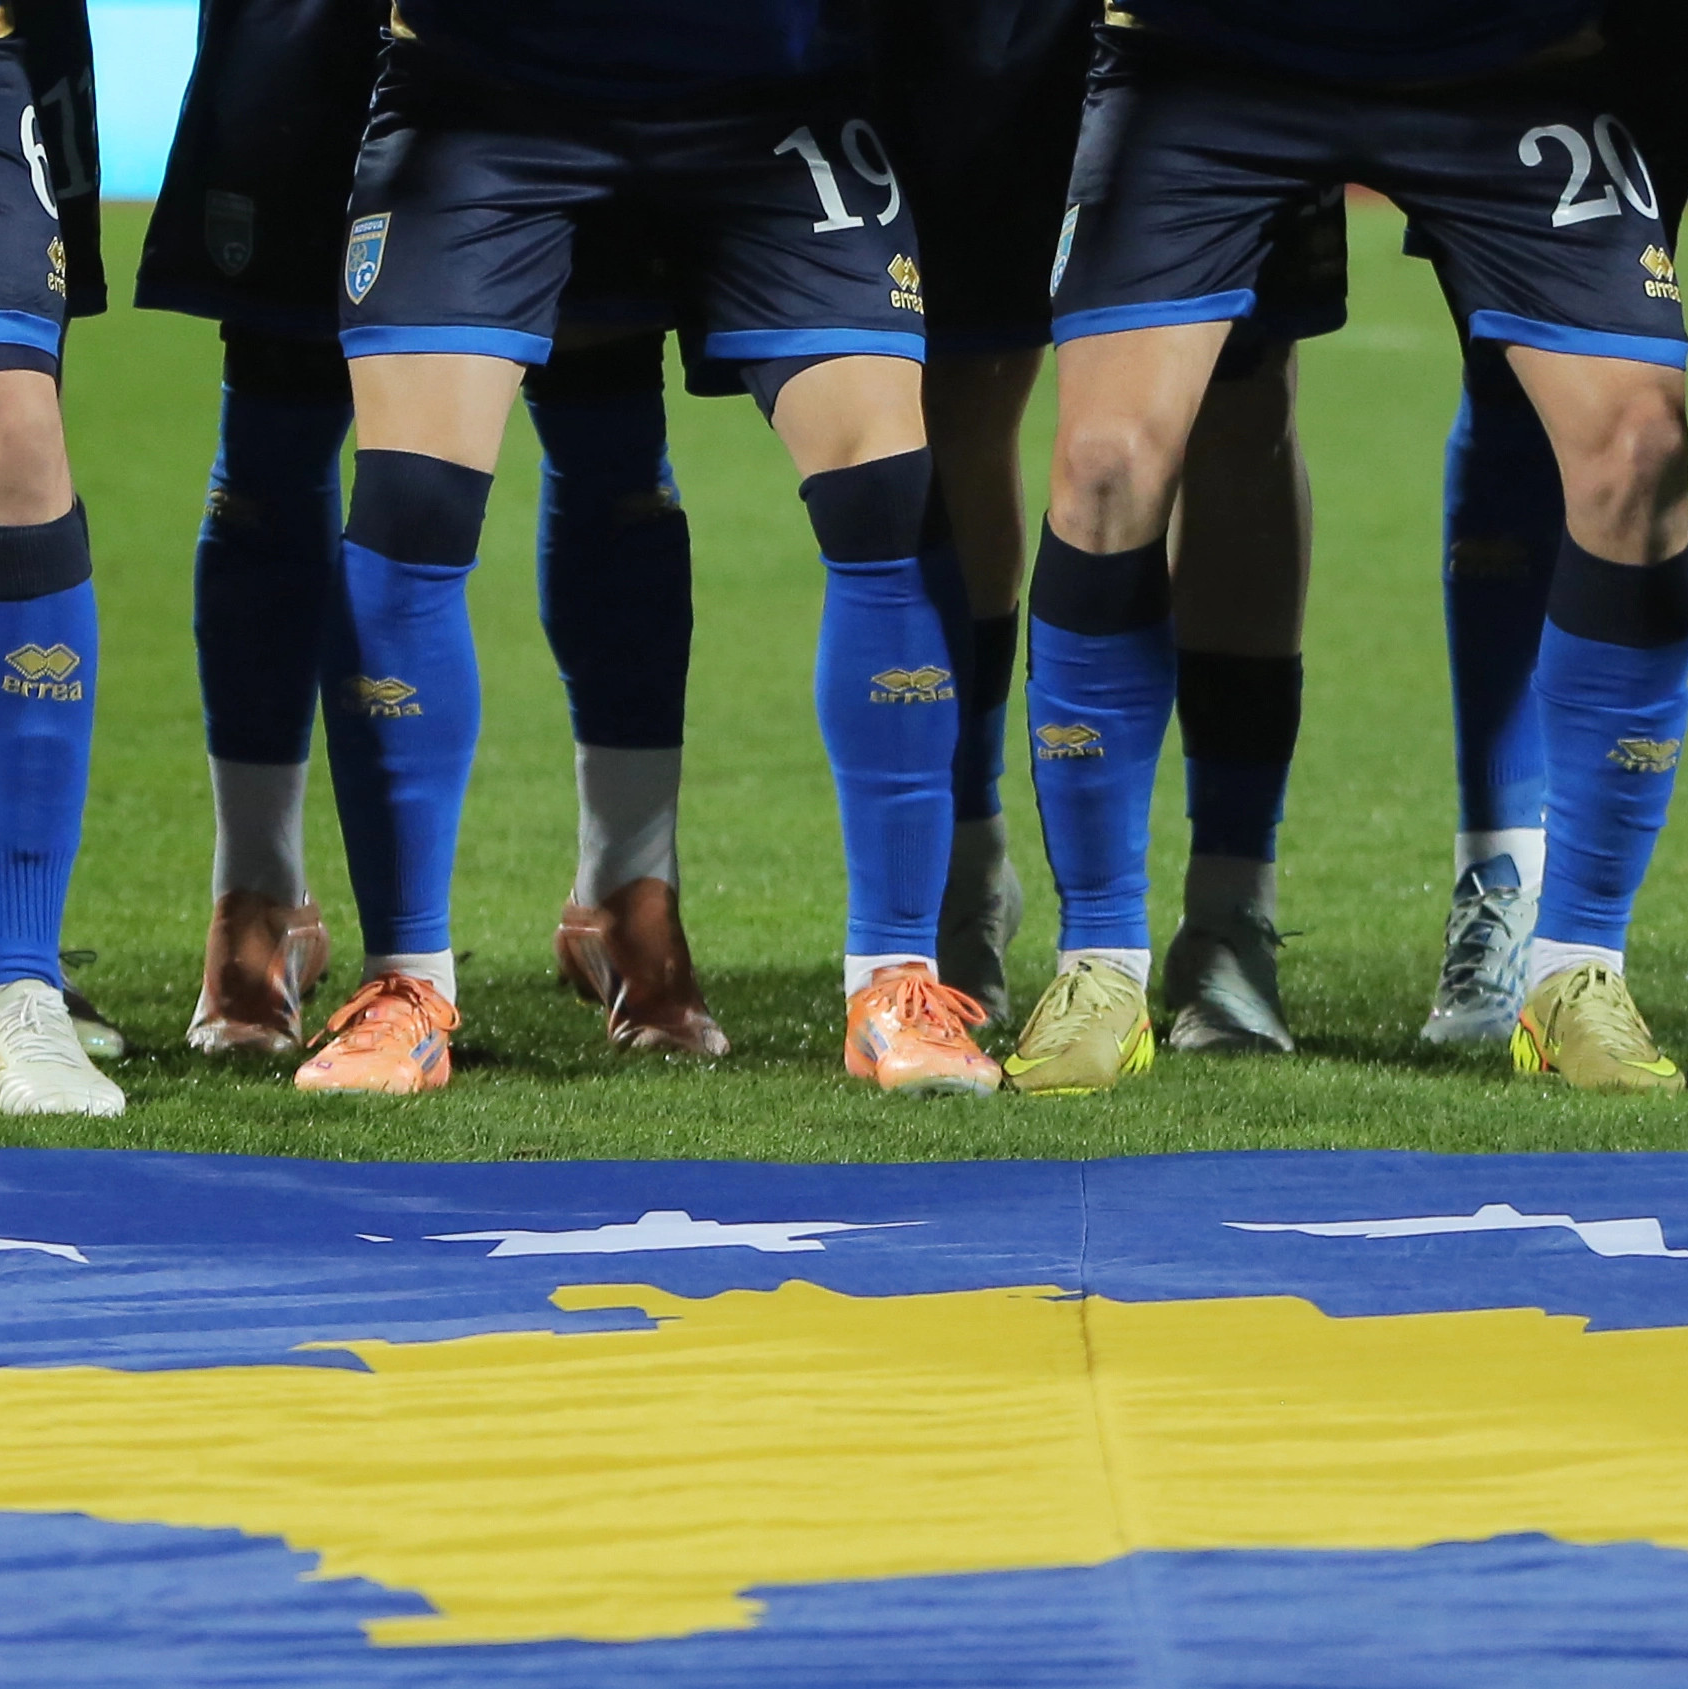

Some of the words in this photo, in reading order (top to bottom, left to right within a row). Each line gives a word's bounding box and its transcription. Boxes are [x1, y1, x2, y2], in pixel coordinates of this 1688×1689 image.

[773, 117, 903, 234] 19
[1518, 112, 1660, 228] 20
[2, 674, 83, 703] errea
